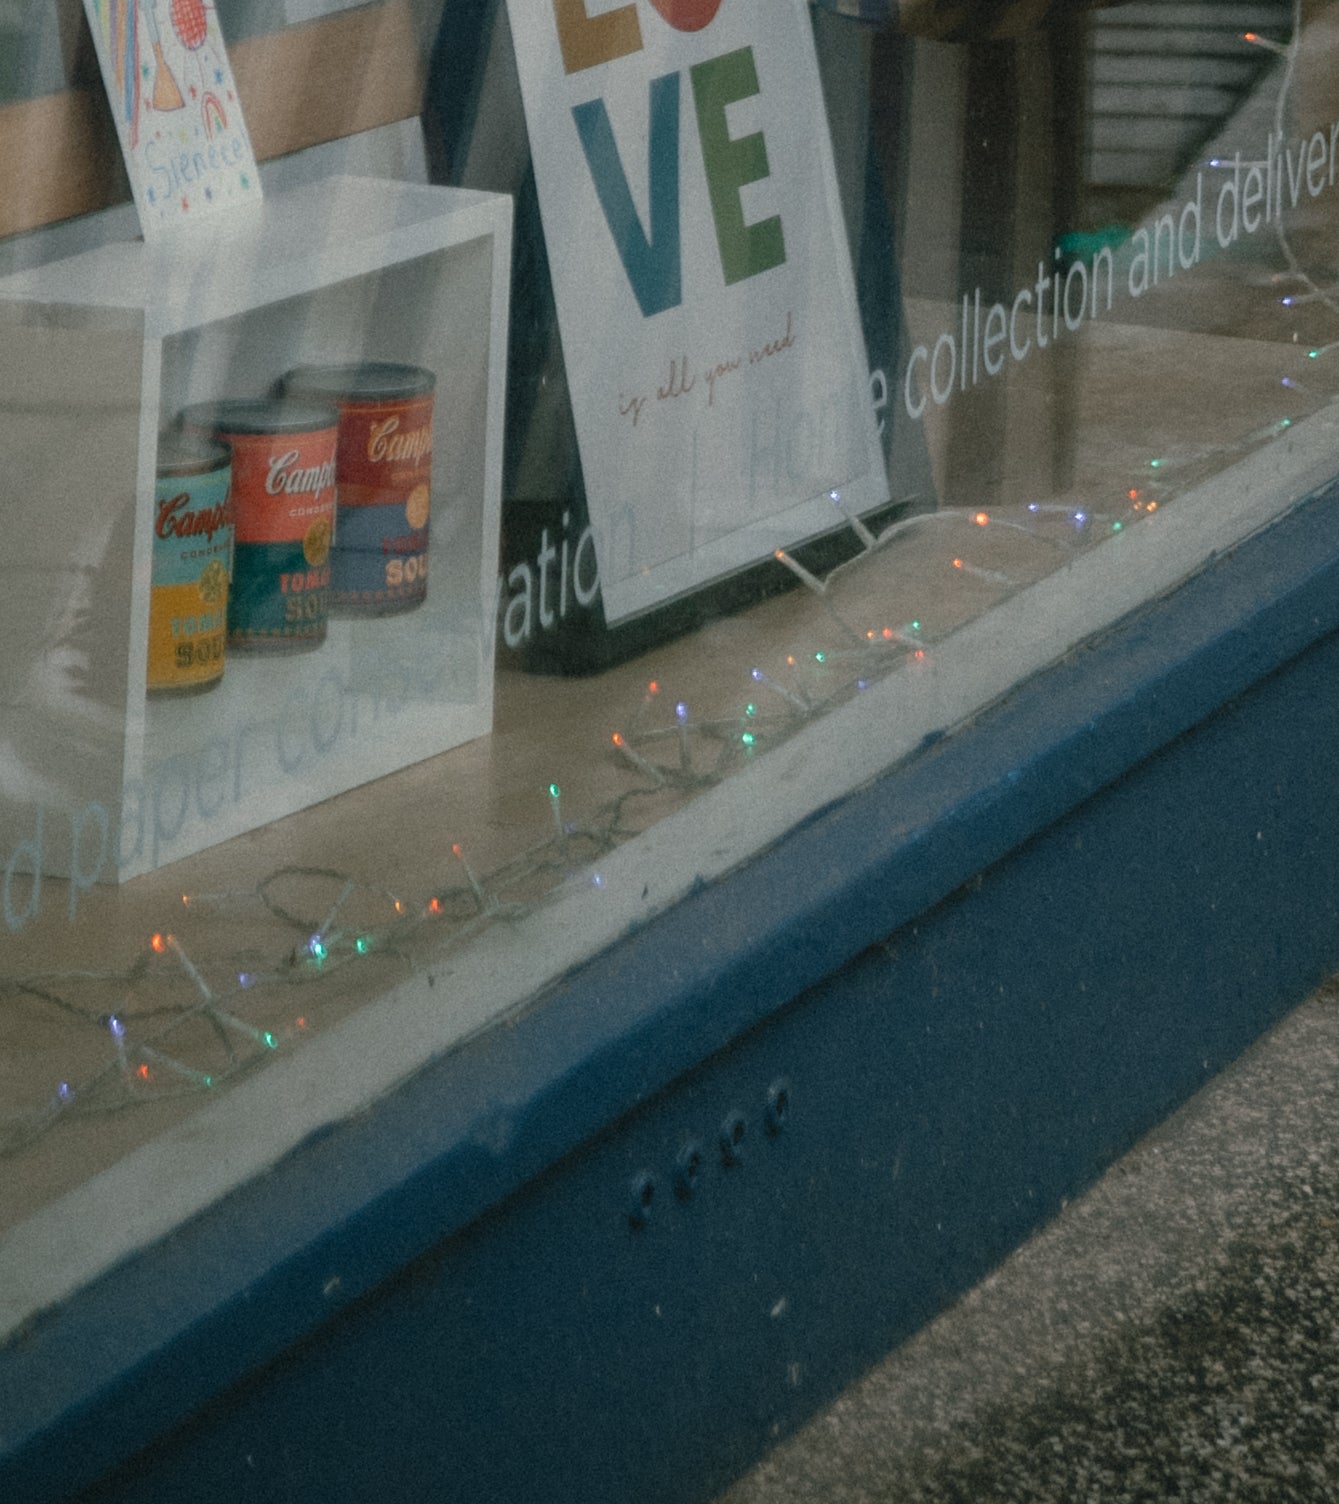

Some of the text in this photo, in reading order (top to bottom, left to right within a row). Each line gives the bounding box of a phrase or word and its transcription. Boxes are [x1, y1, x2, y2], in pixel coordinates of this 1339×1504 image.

[904, 246, 1113, 420] collection
[1128, 193, 1202, 298] and
[656, 355, 696, 402] all
